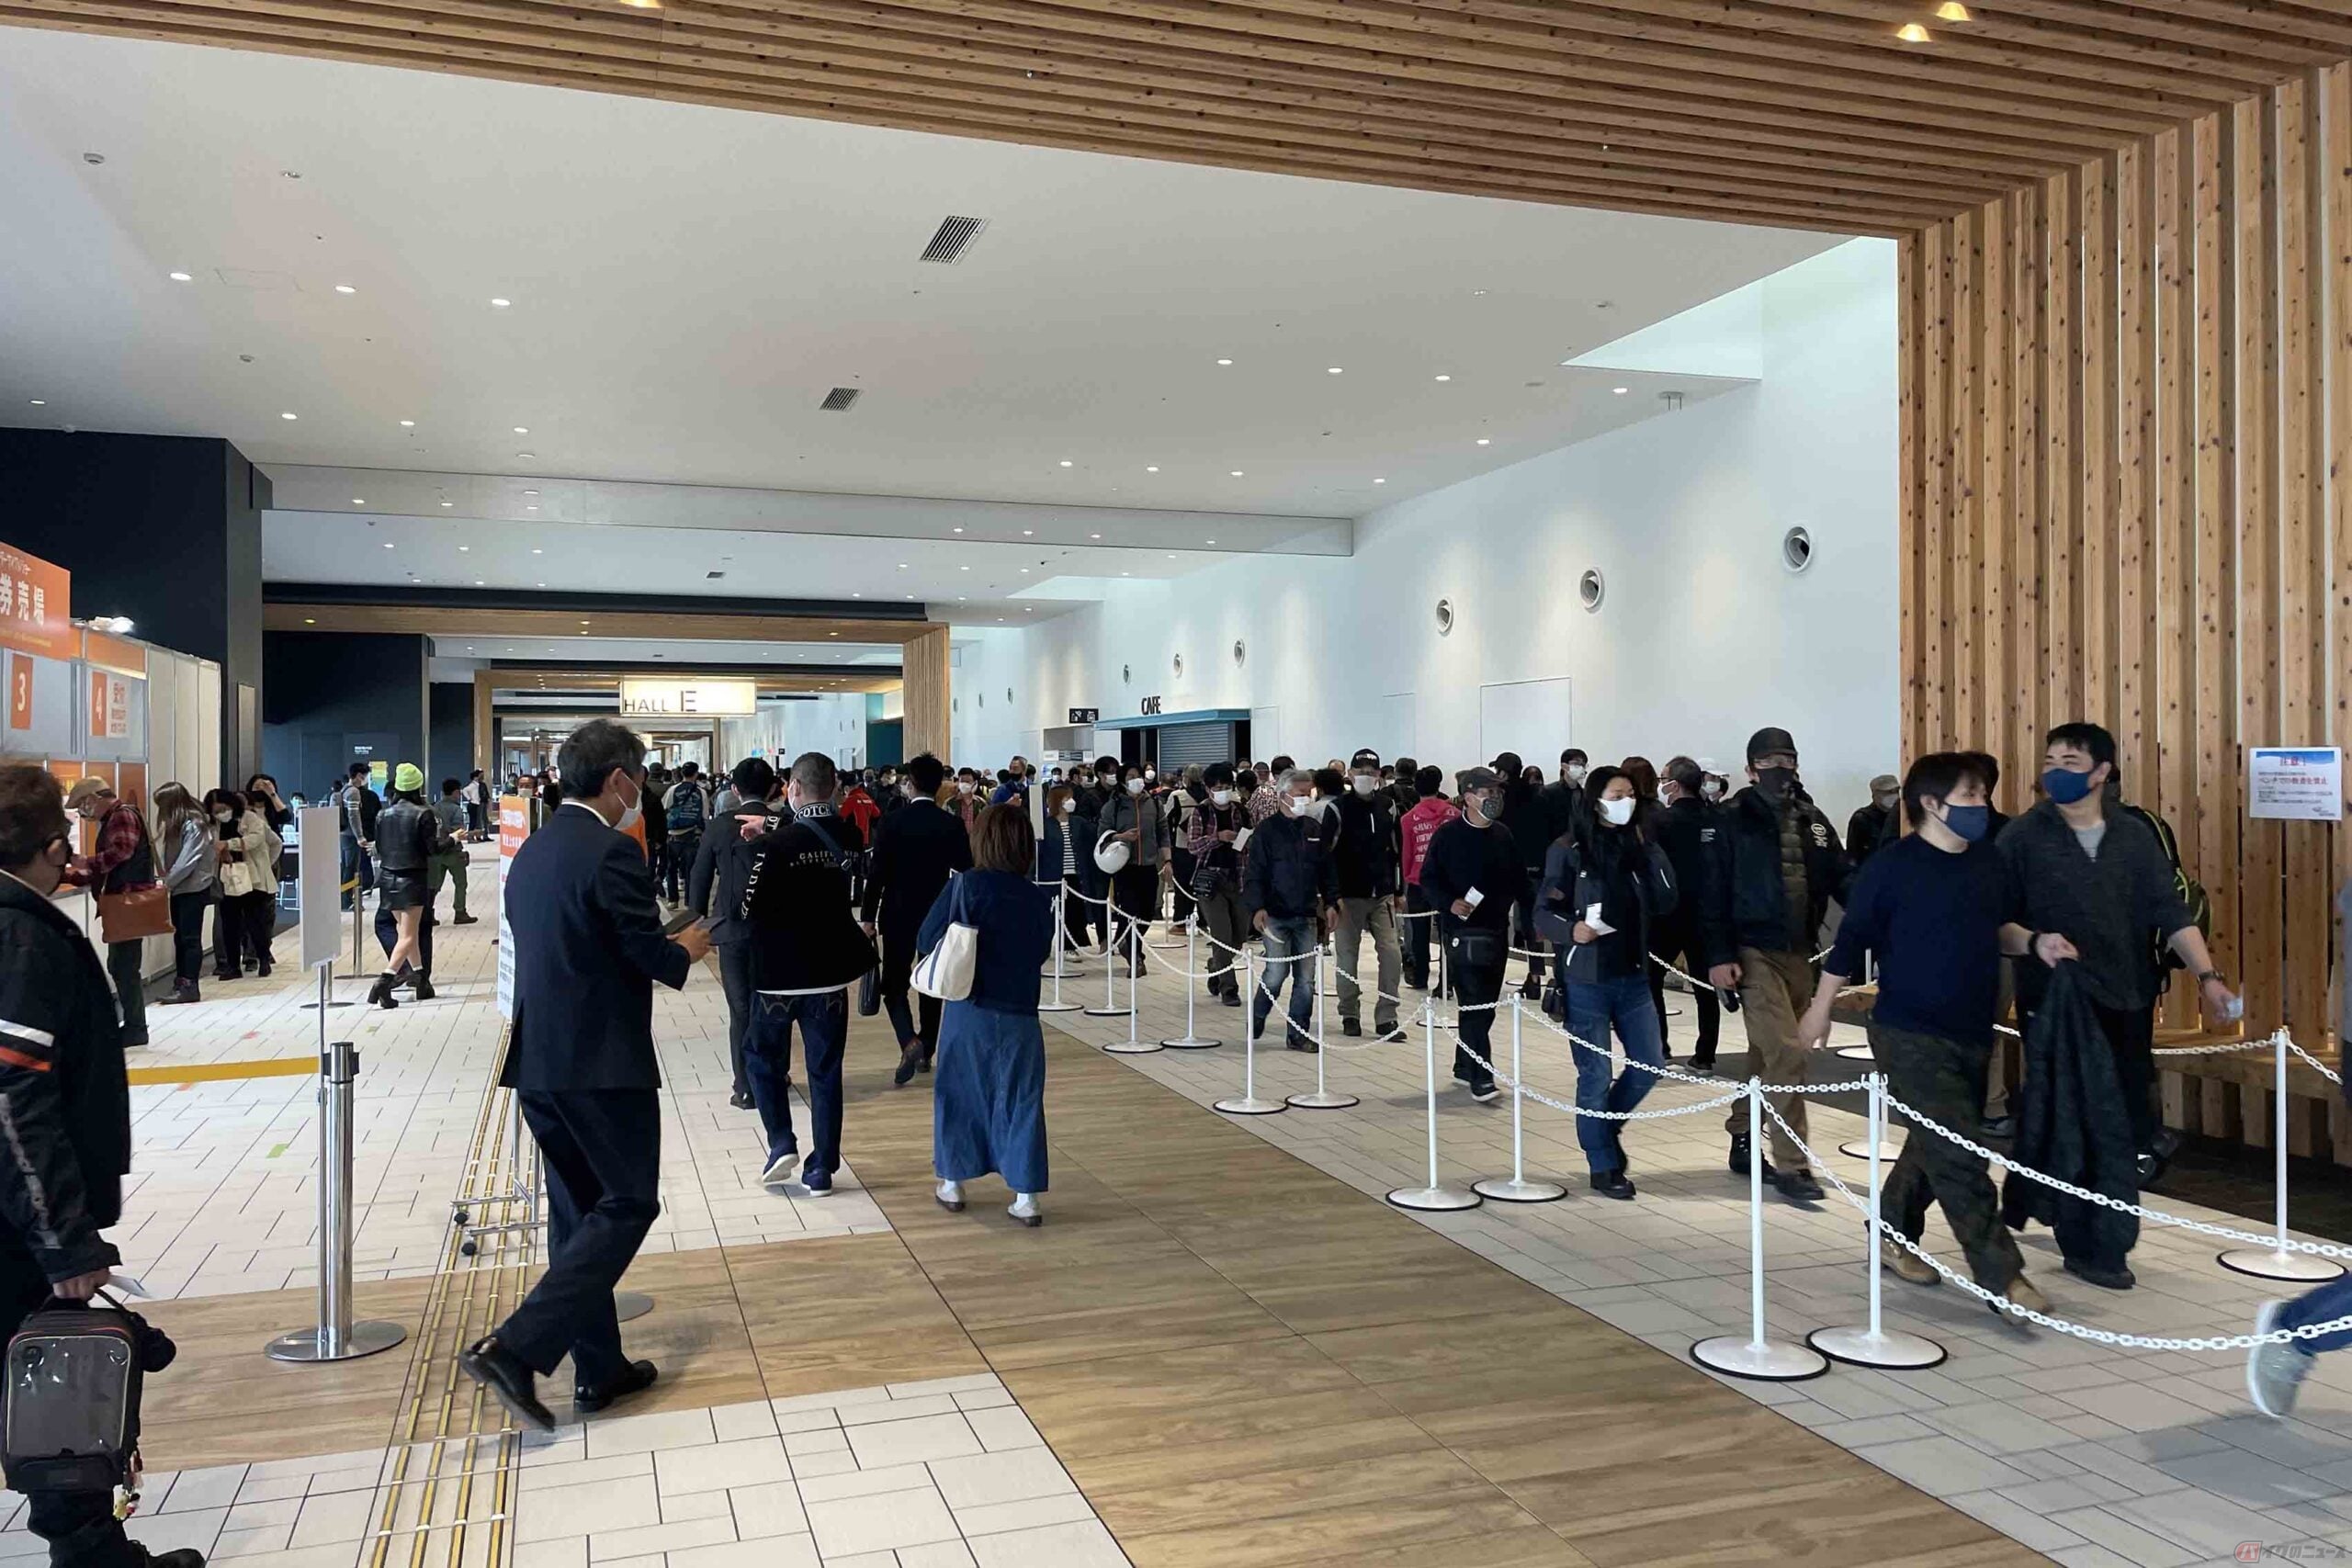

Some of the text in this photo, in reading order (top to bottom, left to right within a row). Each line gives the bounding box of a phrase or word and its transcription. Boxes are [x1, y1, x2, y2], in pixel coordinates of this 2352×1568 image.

[17, 671, 26, 711] 3
[96, 686, 102, 720] 4
[624, 690, 696, 712] HALL E
[1141, 695, 1161, 716] CAFE
